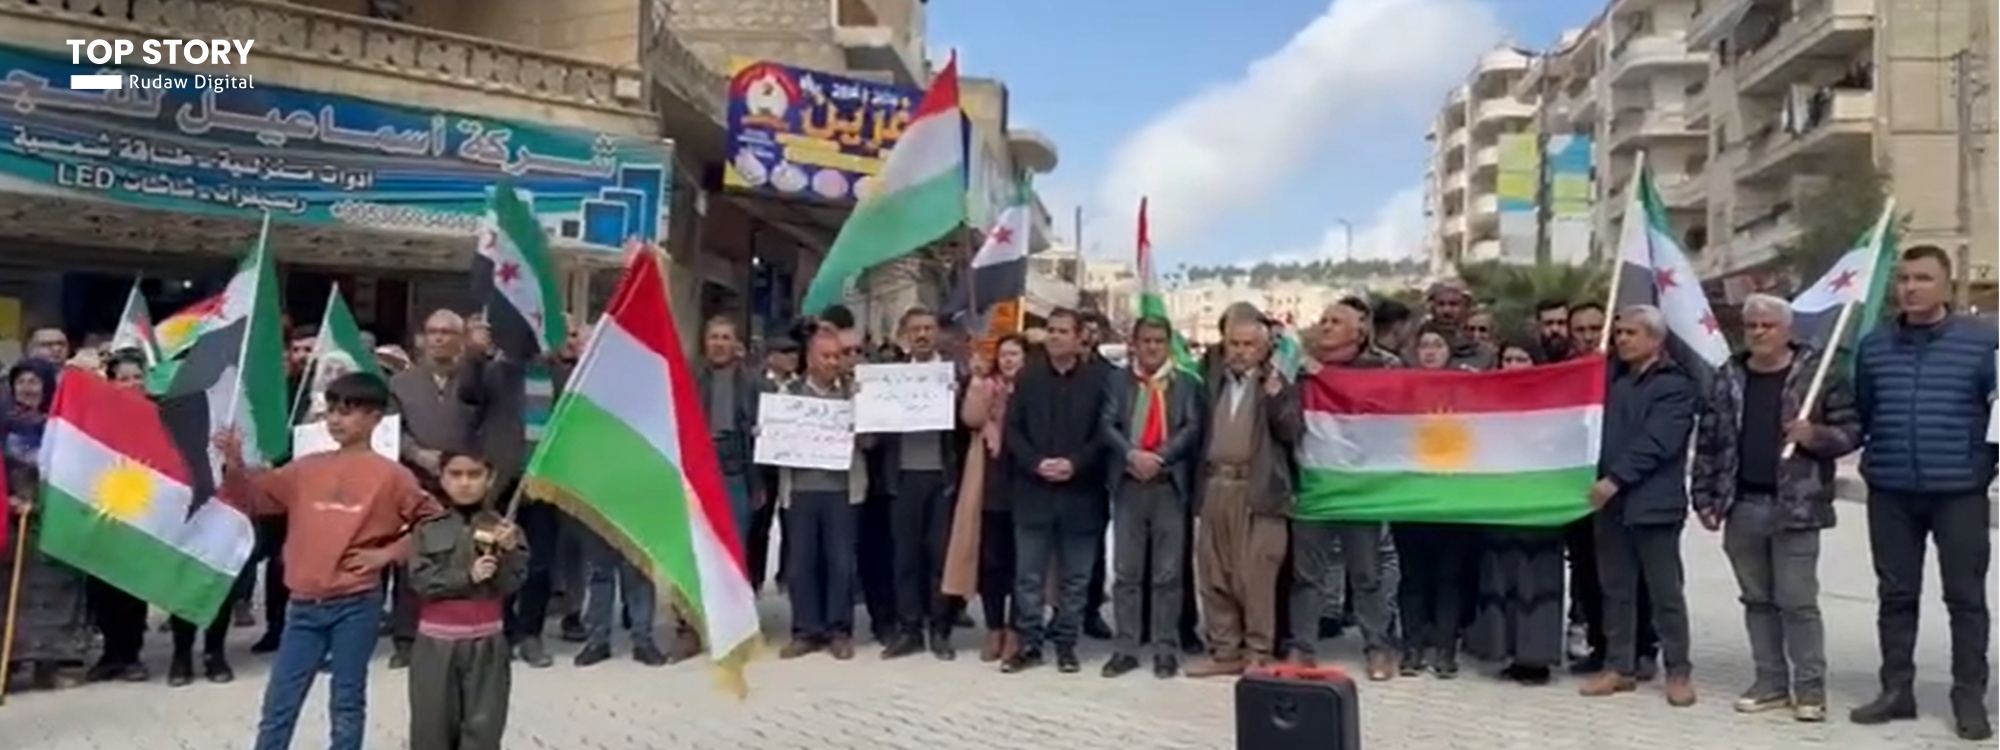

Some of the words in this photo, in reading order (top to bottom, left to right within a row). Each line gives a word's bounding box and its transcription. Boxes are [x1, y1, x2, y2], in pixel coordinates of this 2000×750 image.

[12, 125, 112, 157] شمسية
[118, 137, 194, 166] طاقة
[457, 119, 616, 177] شركة
[57, 162, 115, 190] LED
[217, 150, 314, 181] منزلية
